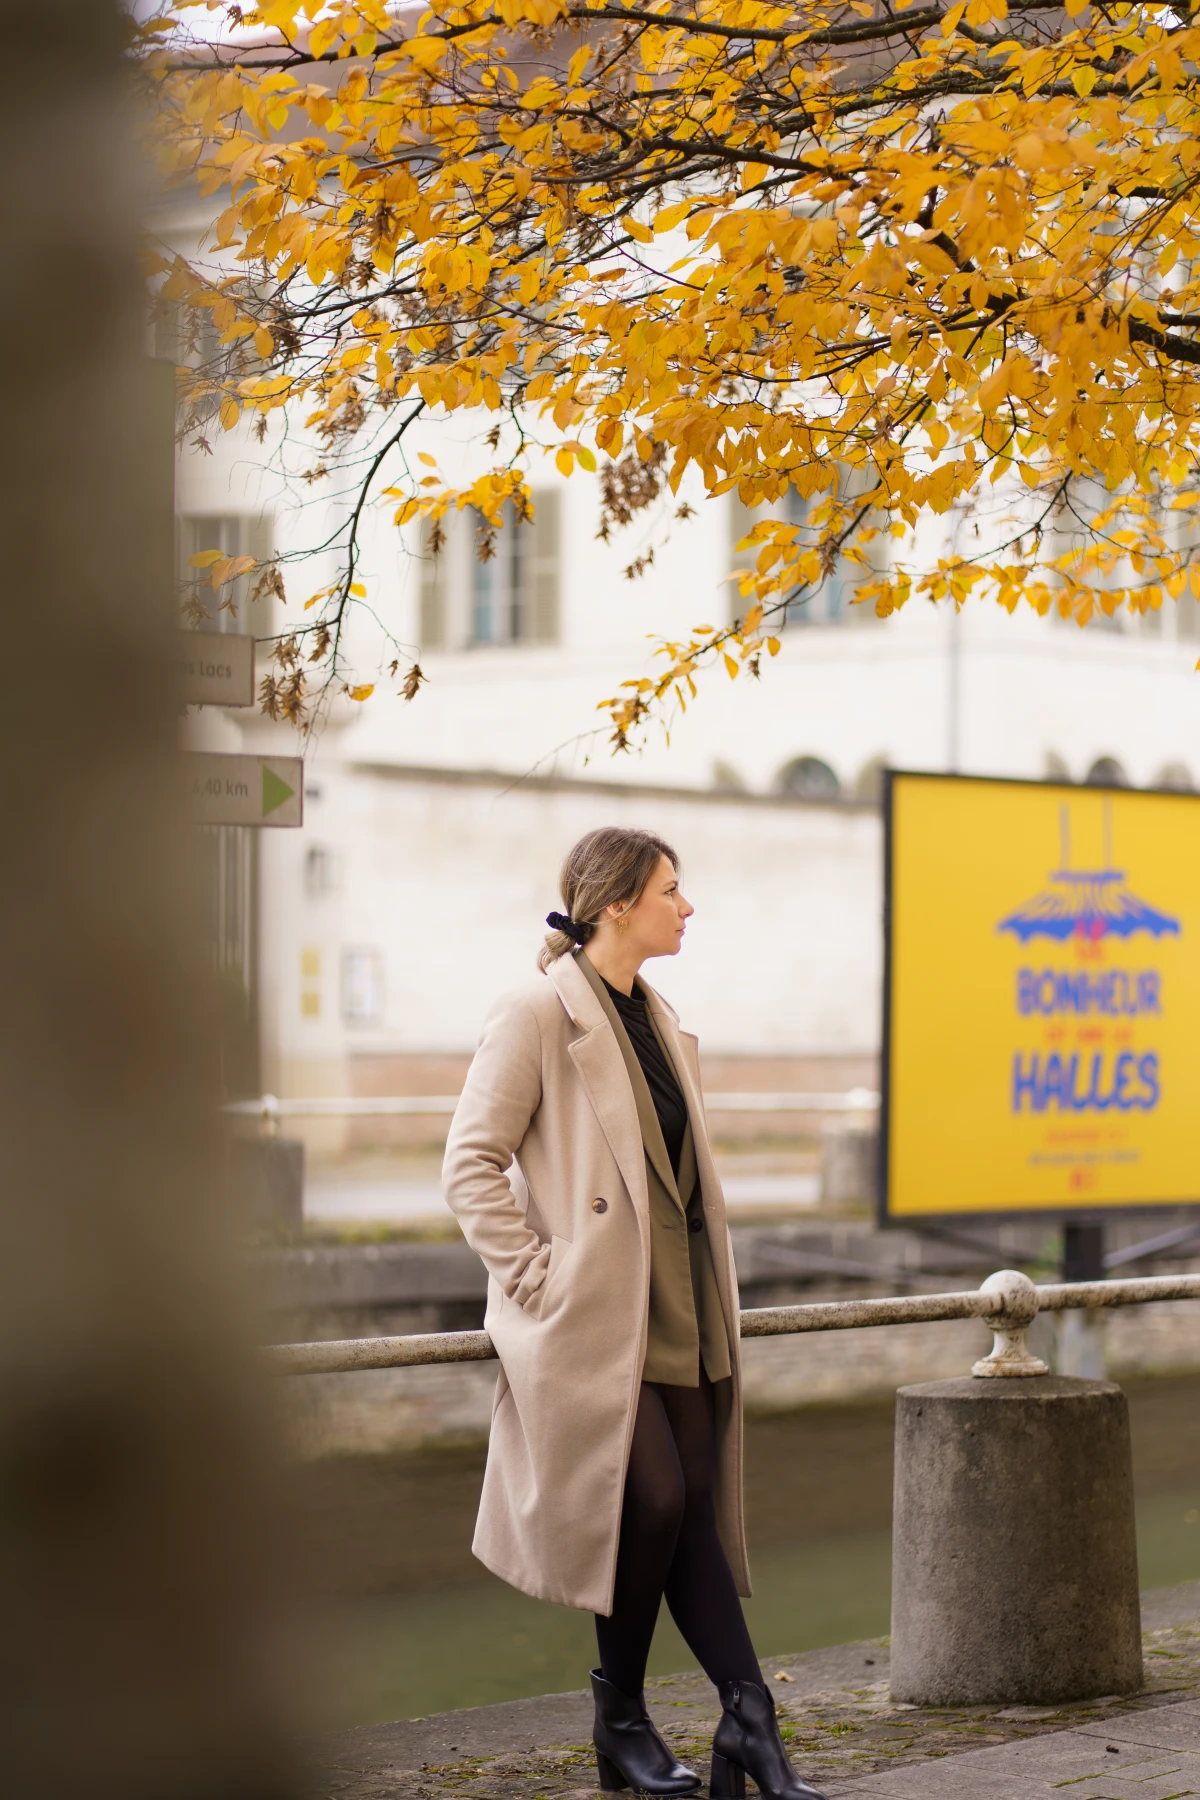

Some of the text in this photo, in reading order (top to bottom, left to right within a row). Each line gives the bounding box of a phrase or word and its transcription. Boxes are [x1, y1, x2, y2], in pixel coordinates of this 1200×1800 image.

[226, 779, 249, 798] km
[1017, 967, 1162, 1018] BONHEUR
[1012, 1051, 1161, 1115] HALLES
